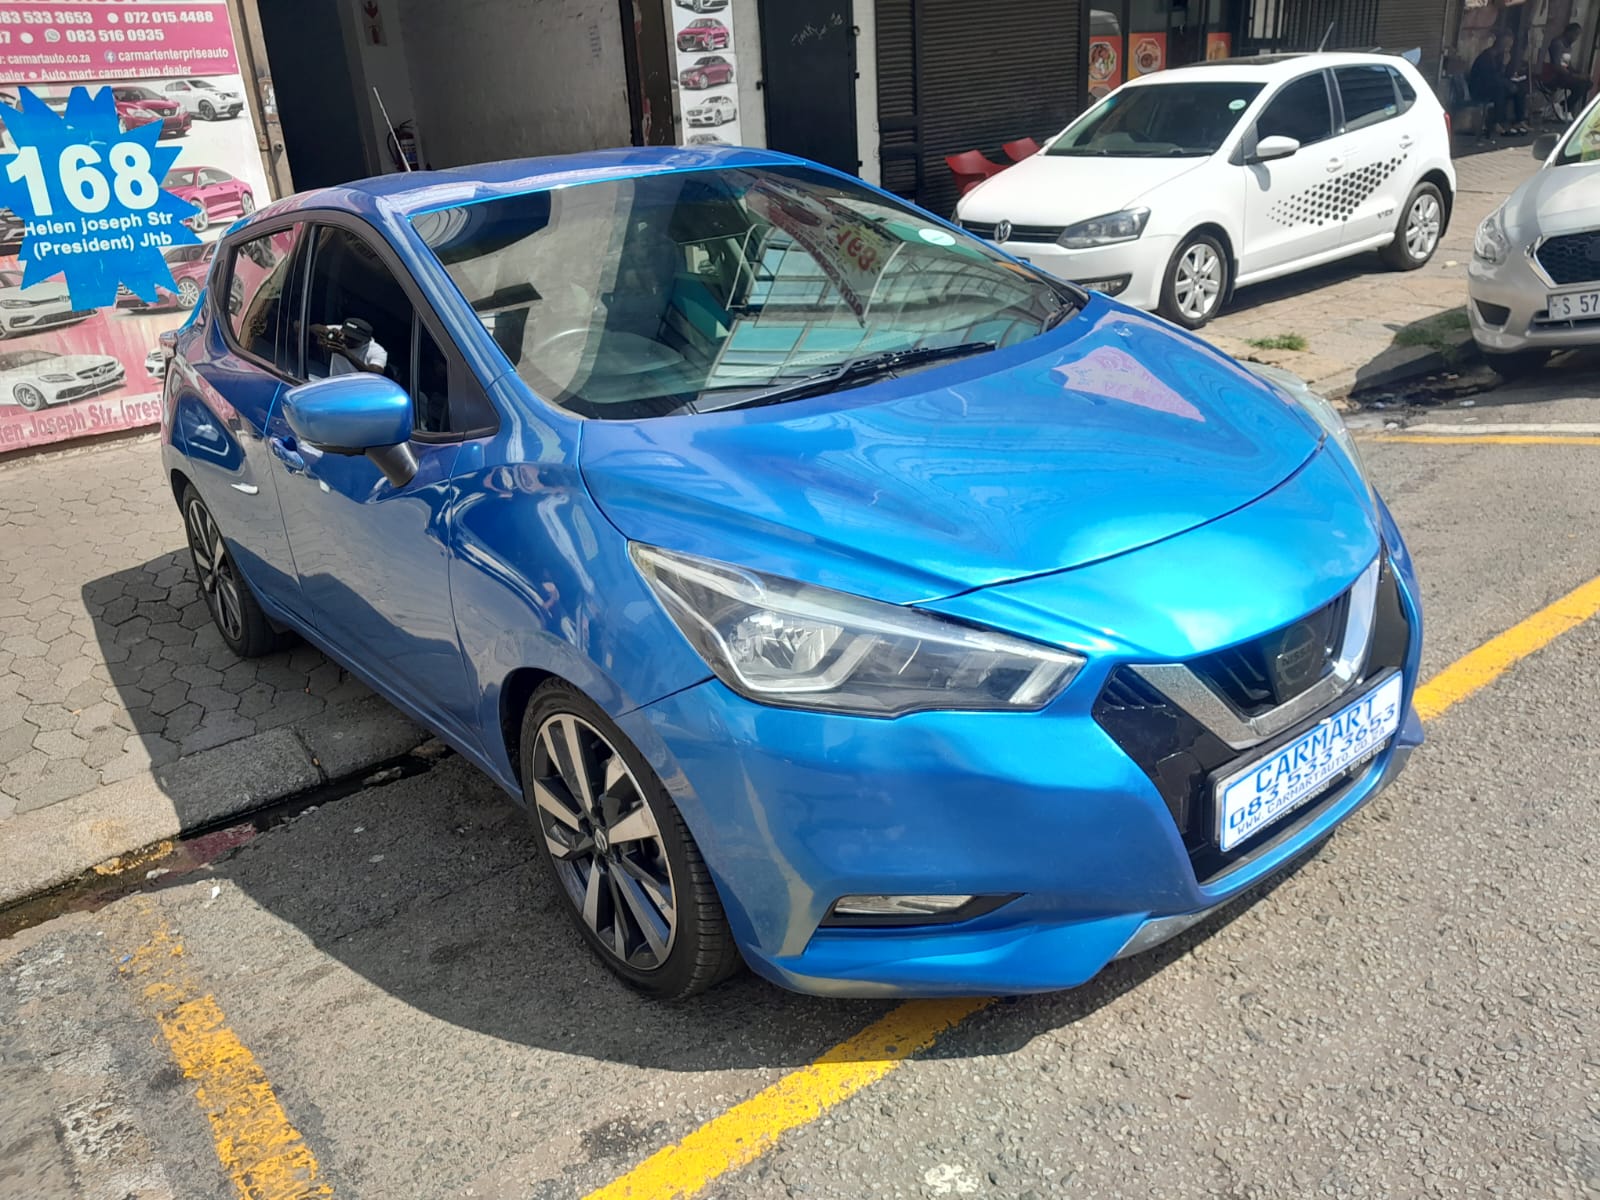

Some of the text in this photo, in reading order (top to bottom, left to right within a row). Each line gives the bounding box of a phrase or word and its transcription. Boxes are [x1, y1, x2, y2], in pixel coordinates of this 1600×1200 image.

[0, 11, 94, 24] 83 533 3653
[124, 11, 150, 24] 072
[151, 11, 177, 23] 015
[65, 28, 165, 42] 083 516 0935
[8, 53, 91, 65] carmartauto.co.za
[118, 46, 229, 62] carmartenterpriseauto
[41, 68, 67, 81] Auto
[98, 66, 136, 79] carmart
[138, 65, 161, 77] auto
[162, 63, 193, 76] dealer
[6, 141, 159, 216] 168
[24, 211, 173, 237] Helen joseph Str
[33, 231, 173, 261] (President) Jhb
[1562, 297, 1571, 315] S
[28, 407, 86, 439] Joseph
[1256, 693, 1377, 793] CARMART
[1230, 782, 1279, 829] 083
[1287, 747, 1333, 789] 533
[1340, 702, 1395, 752] 3653
